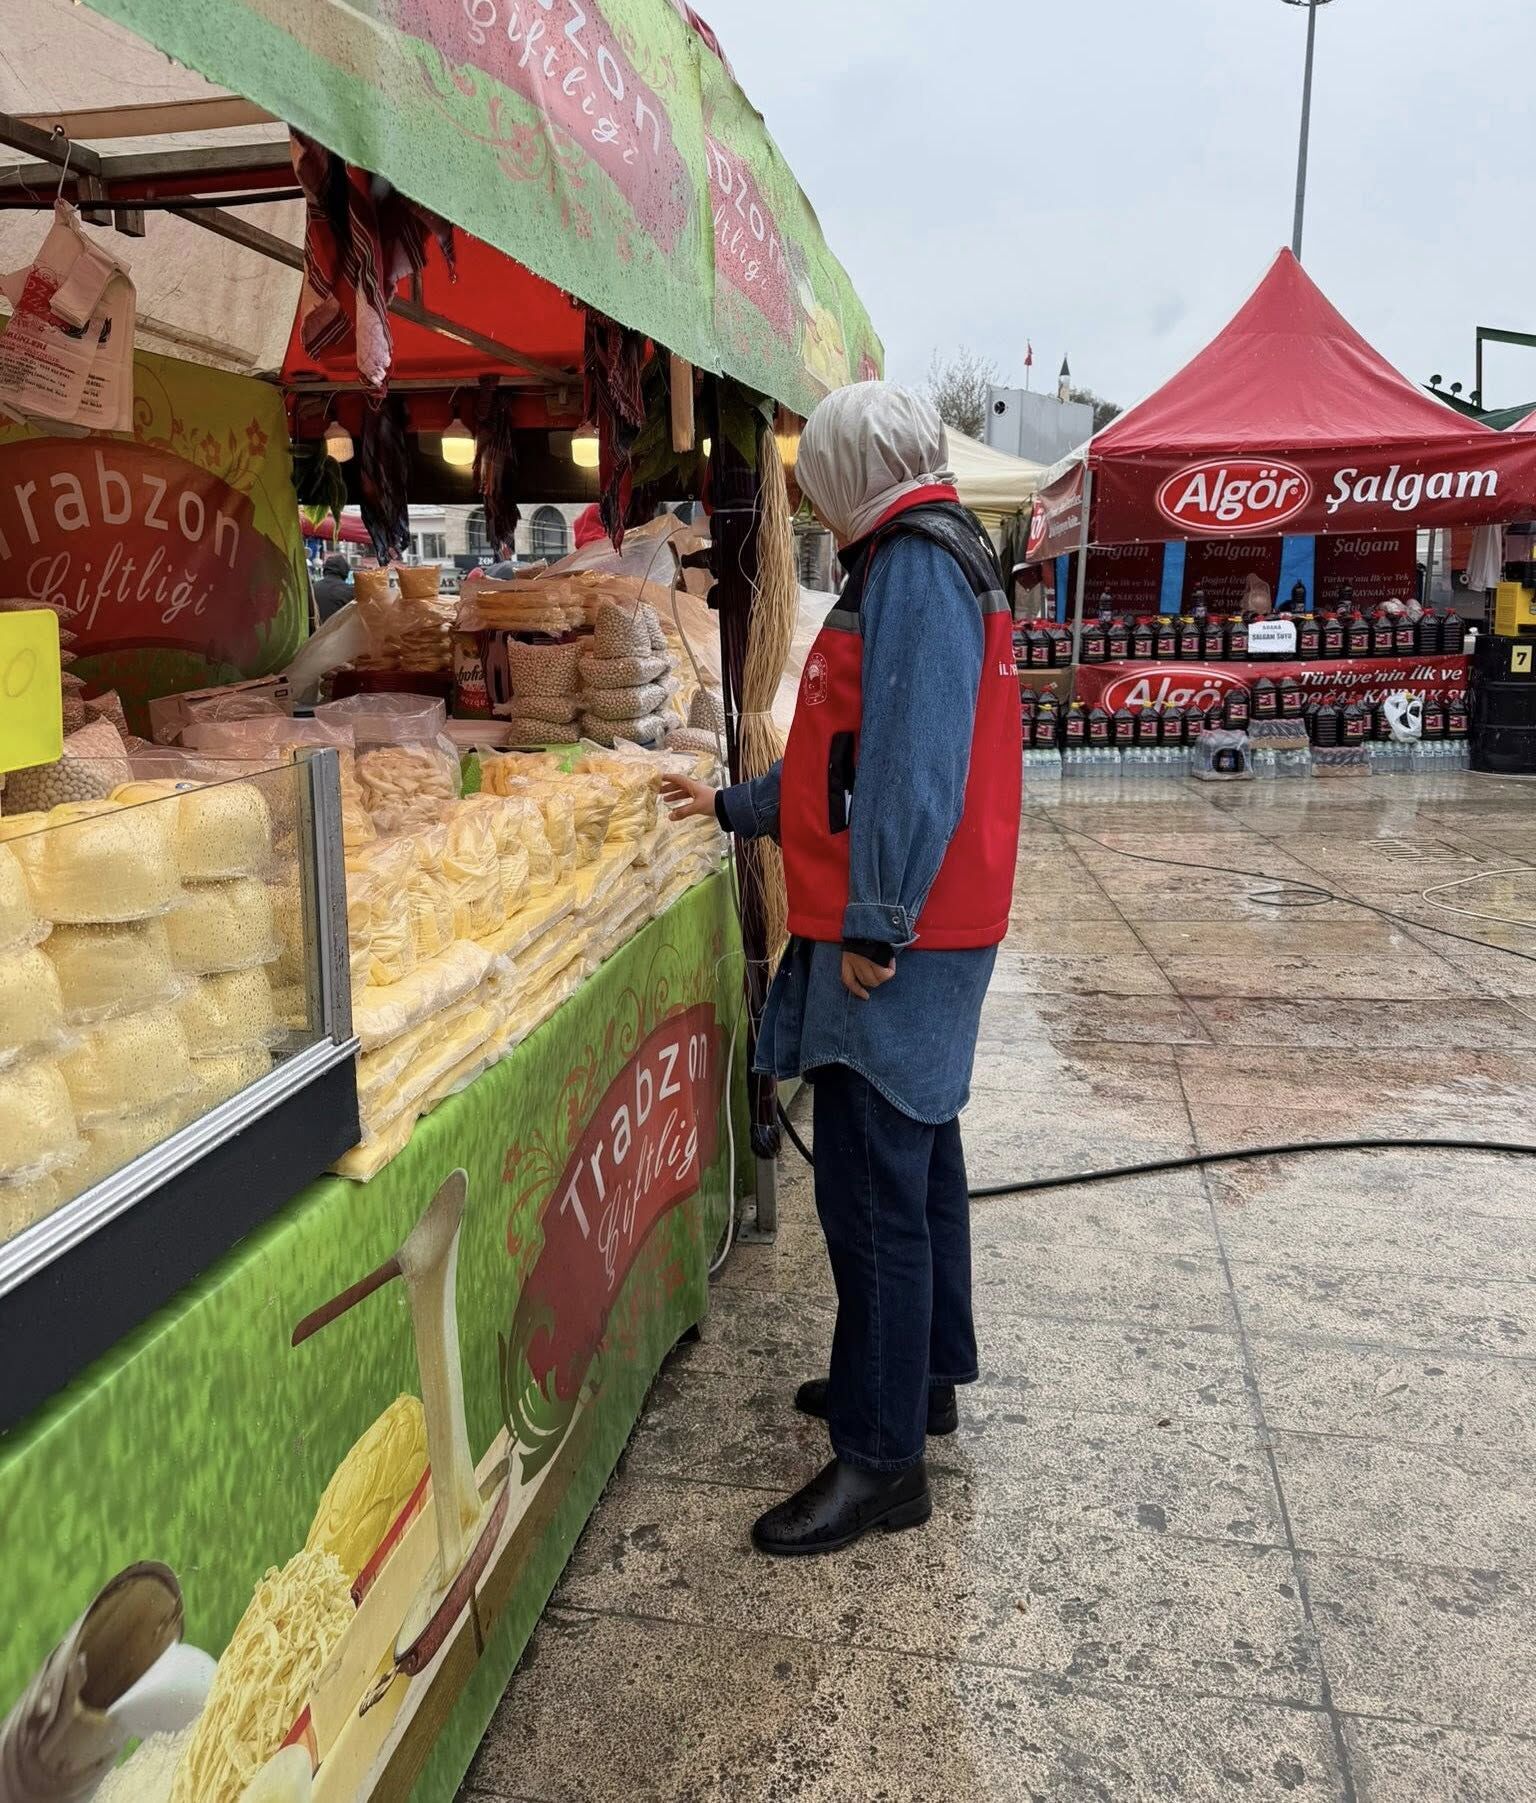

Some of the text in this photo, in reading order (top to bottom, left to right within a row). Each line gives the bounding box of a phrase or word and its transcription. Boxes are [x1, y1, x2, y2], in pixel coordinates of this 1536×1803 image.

[1325, 465, 1498, 514] Şalgam
[0, 449, 240, 569] rabzon
[1202, 542, 1267, 560] Şalgam
[1334, 538, 1400, 556] Şalgam
[1516, 651, 1528, 666] 7
[1301, 669, 1406, 688] Türkiye'nin
[1409, 664, 1437, 680] İlk
[1441, 669, 1463, 680] ve
[560, 1033, 708, 1240] Trabzon
